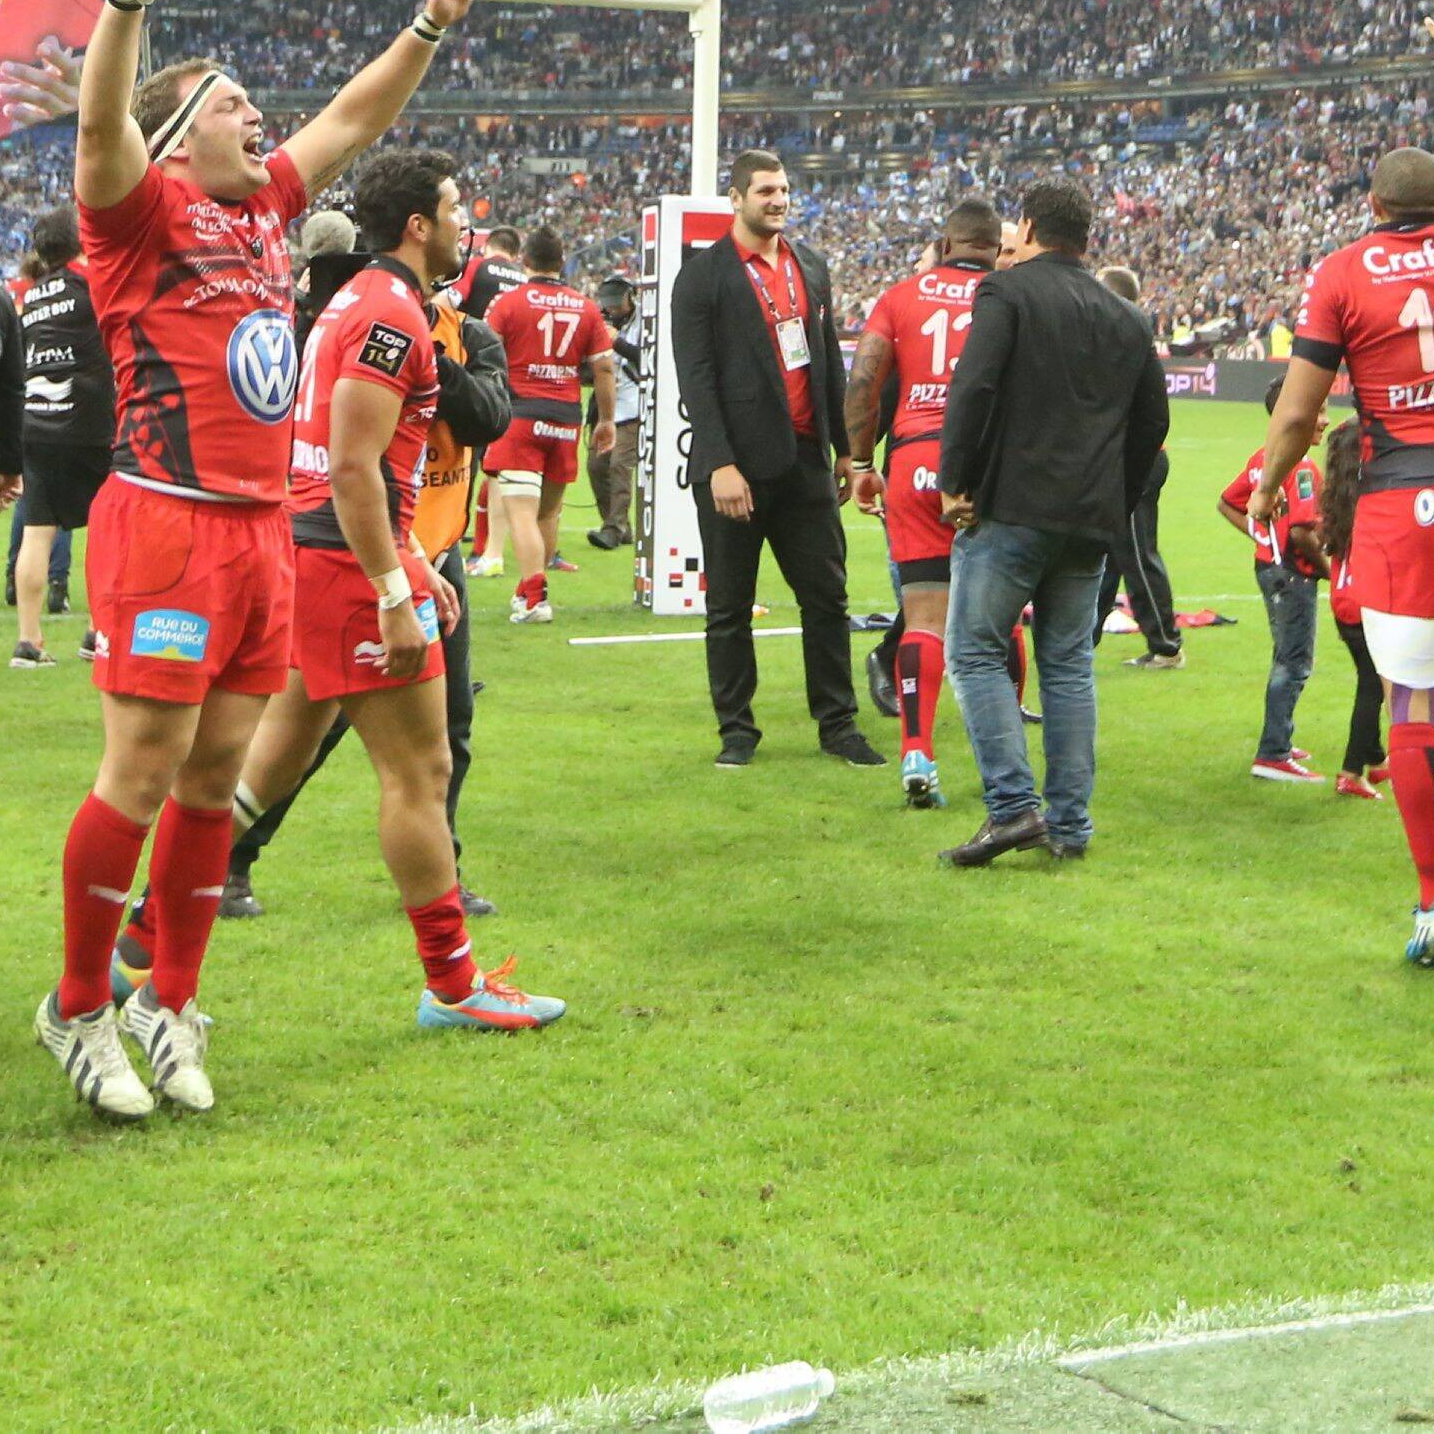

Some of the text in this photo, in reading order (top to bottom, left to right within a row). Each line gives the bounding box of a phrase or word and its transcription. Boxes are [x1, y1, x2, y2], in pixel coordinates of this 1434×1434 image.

[194, 277, 268, 301] TOULON
[918, 273, 976, 299] Craf
[51, 298, 76, 317] BOY
[526, 289, 585, 309] Crafter
[374, 328, 407, 350] TOP
[537, 311, 581, 358] 17
[909, 382, 949, 404] PIZZ
[180, 619, 199, 633] DU
